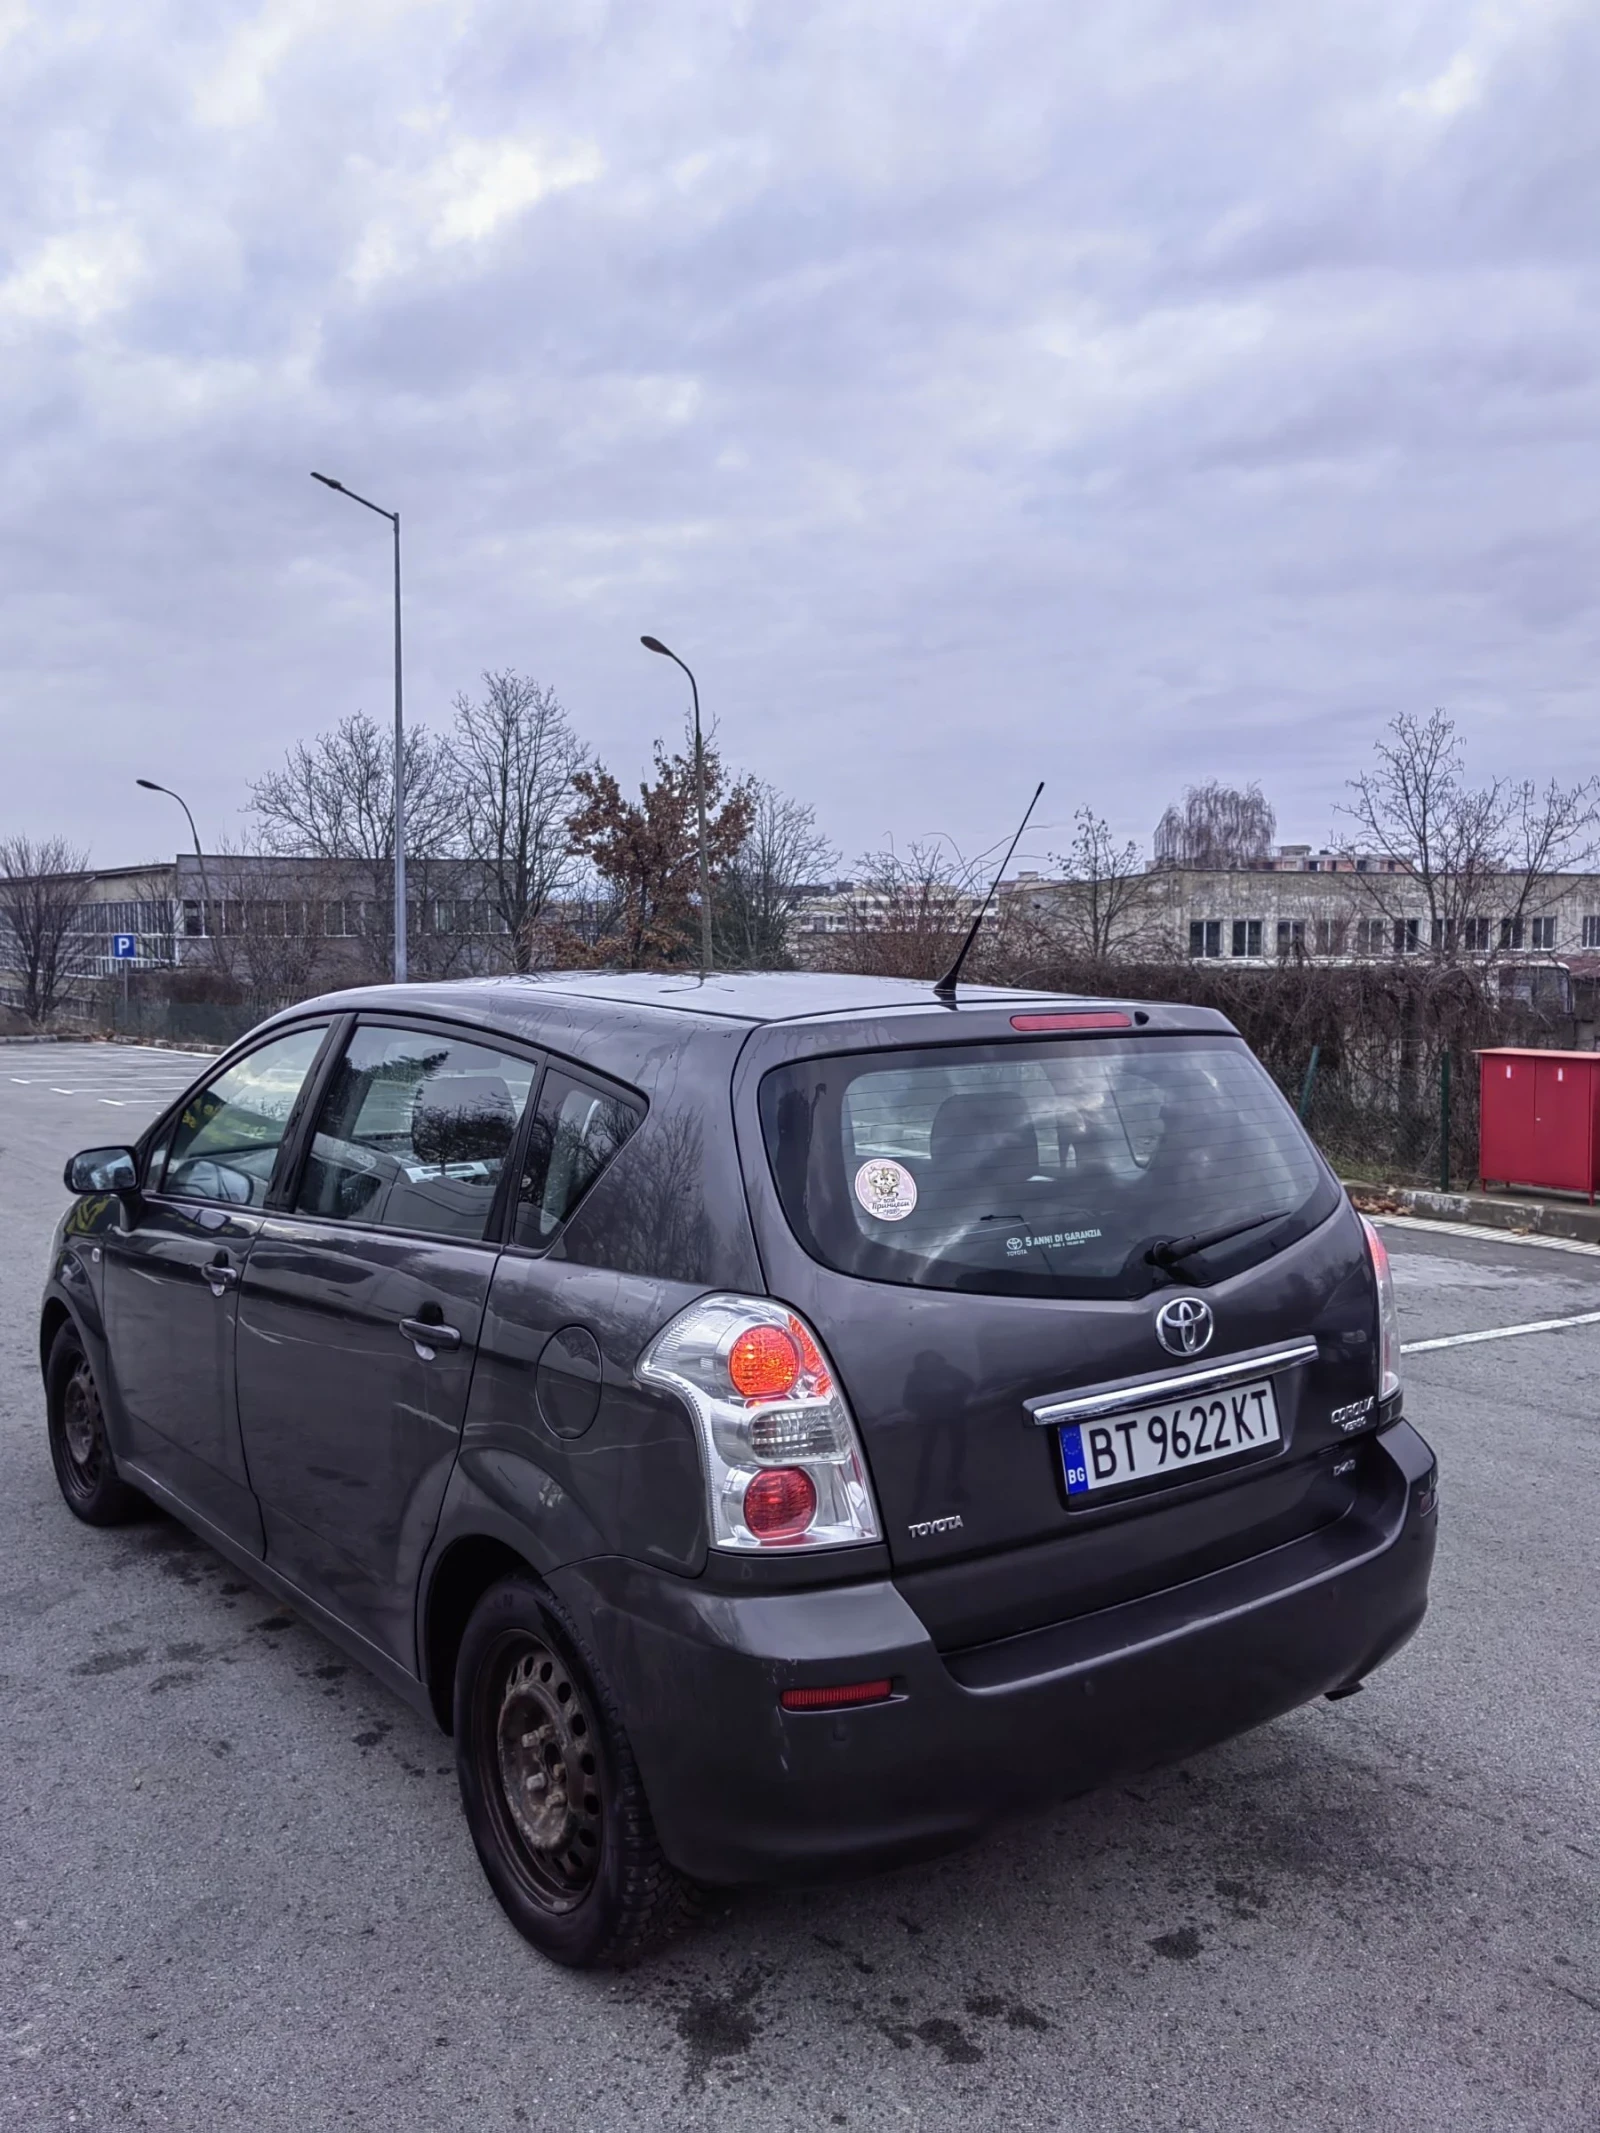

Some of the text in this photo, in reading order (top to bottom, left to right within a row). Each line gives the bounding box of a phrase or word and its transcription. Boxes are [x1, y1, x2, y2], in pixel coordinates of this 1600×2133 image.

[118, 938, 129, 955] P
[1025, 1236, 1032, 1247] 5
[1033, 1234, 1053, 1246] ANNI
[1054, 1233, 1063, 1243] DI
[1064, 1228, 1102, 1241] GARANZIA
[1006, 1248, 1028, 1257] TOYOTA
[1067, 1466, 1086, 1485] BG
[907, 1514, 964, 1539] TOYOTA
